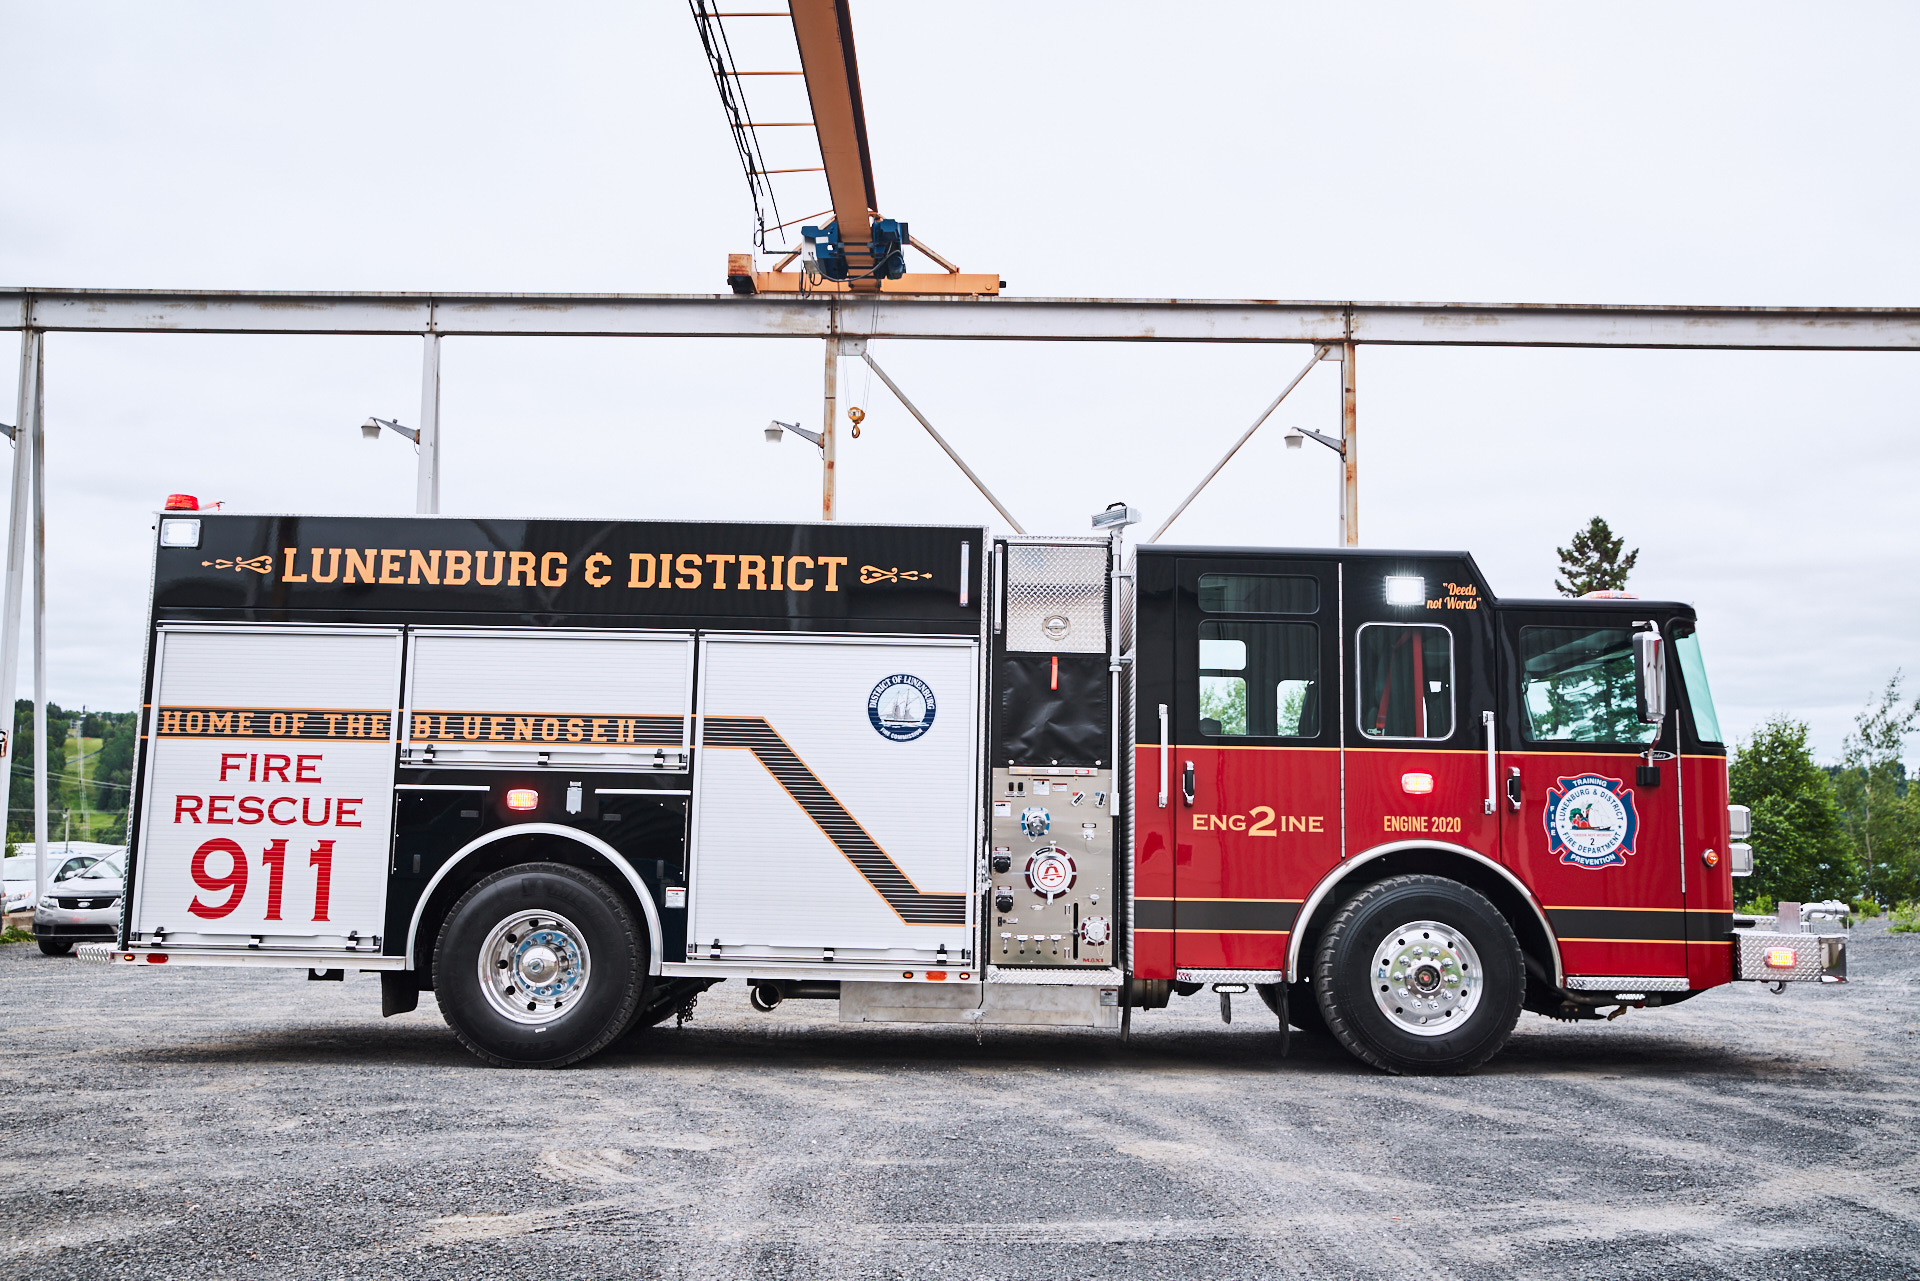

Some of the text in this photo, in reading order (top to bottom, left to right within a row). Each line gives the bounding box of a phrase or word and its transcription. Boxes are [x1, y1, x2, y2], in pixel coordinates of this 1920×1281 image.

[281, 547, 848, 592] LUNENBURG & DISTRICT
[1442, 582, 1477, 596] "Deeds
[1426, 596, 1482, 610] not Words"
[869, 675, 935, 710] DISTRICT OF LUNENBURG
[161, 711, 255, 734] HOME
[269, 712, 308, 736] OF
[324, 713, 388, 738] THE
[219, 752, 323, 784] FIRE
[1571, 777, 1608, 787] TRAINING
[173, 794, 364, 828] RESCUE
[1558, 788, 1590, 822] LUNENBURG
[1600, 790, 1624, 821] DISTRICT
[1383, 815, 1461, 833] ENGINE 2020
[1562, 830, 1621, 854] FIRE DEPARTMENT
[1590, 837, 1595, 846] 2
[1570, 853, 1616, 866] PREVENTION
[187, 837, 337, 922] 911
